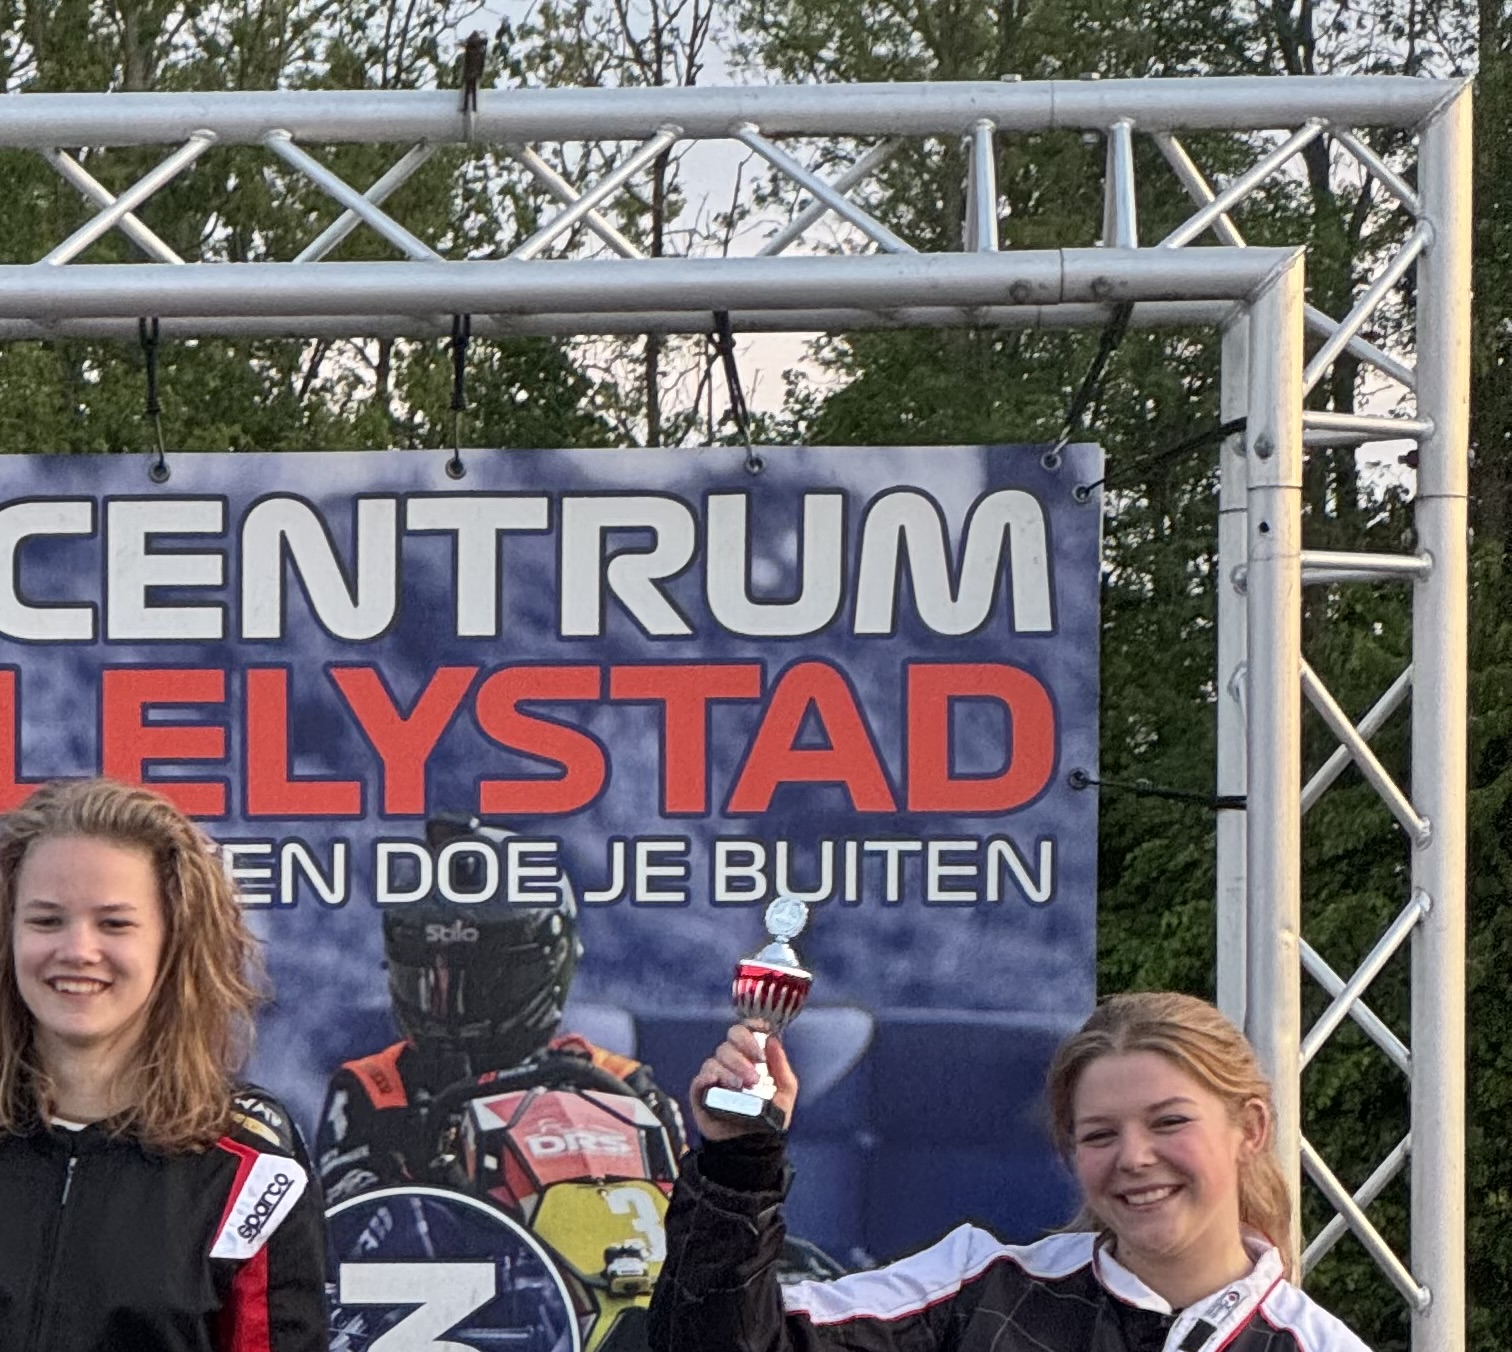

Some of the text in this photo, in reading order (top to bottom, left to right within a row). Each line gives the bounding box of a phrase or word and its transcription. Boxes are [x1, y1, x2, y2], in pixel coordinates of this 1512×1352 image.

[376, 841, 561, 903] DOE
[584, 840, 687, 903] JE
[714, 838, 1053, 904] BUITEN
[237, 1172, 292, 1244] sparco
